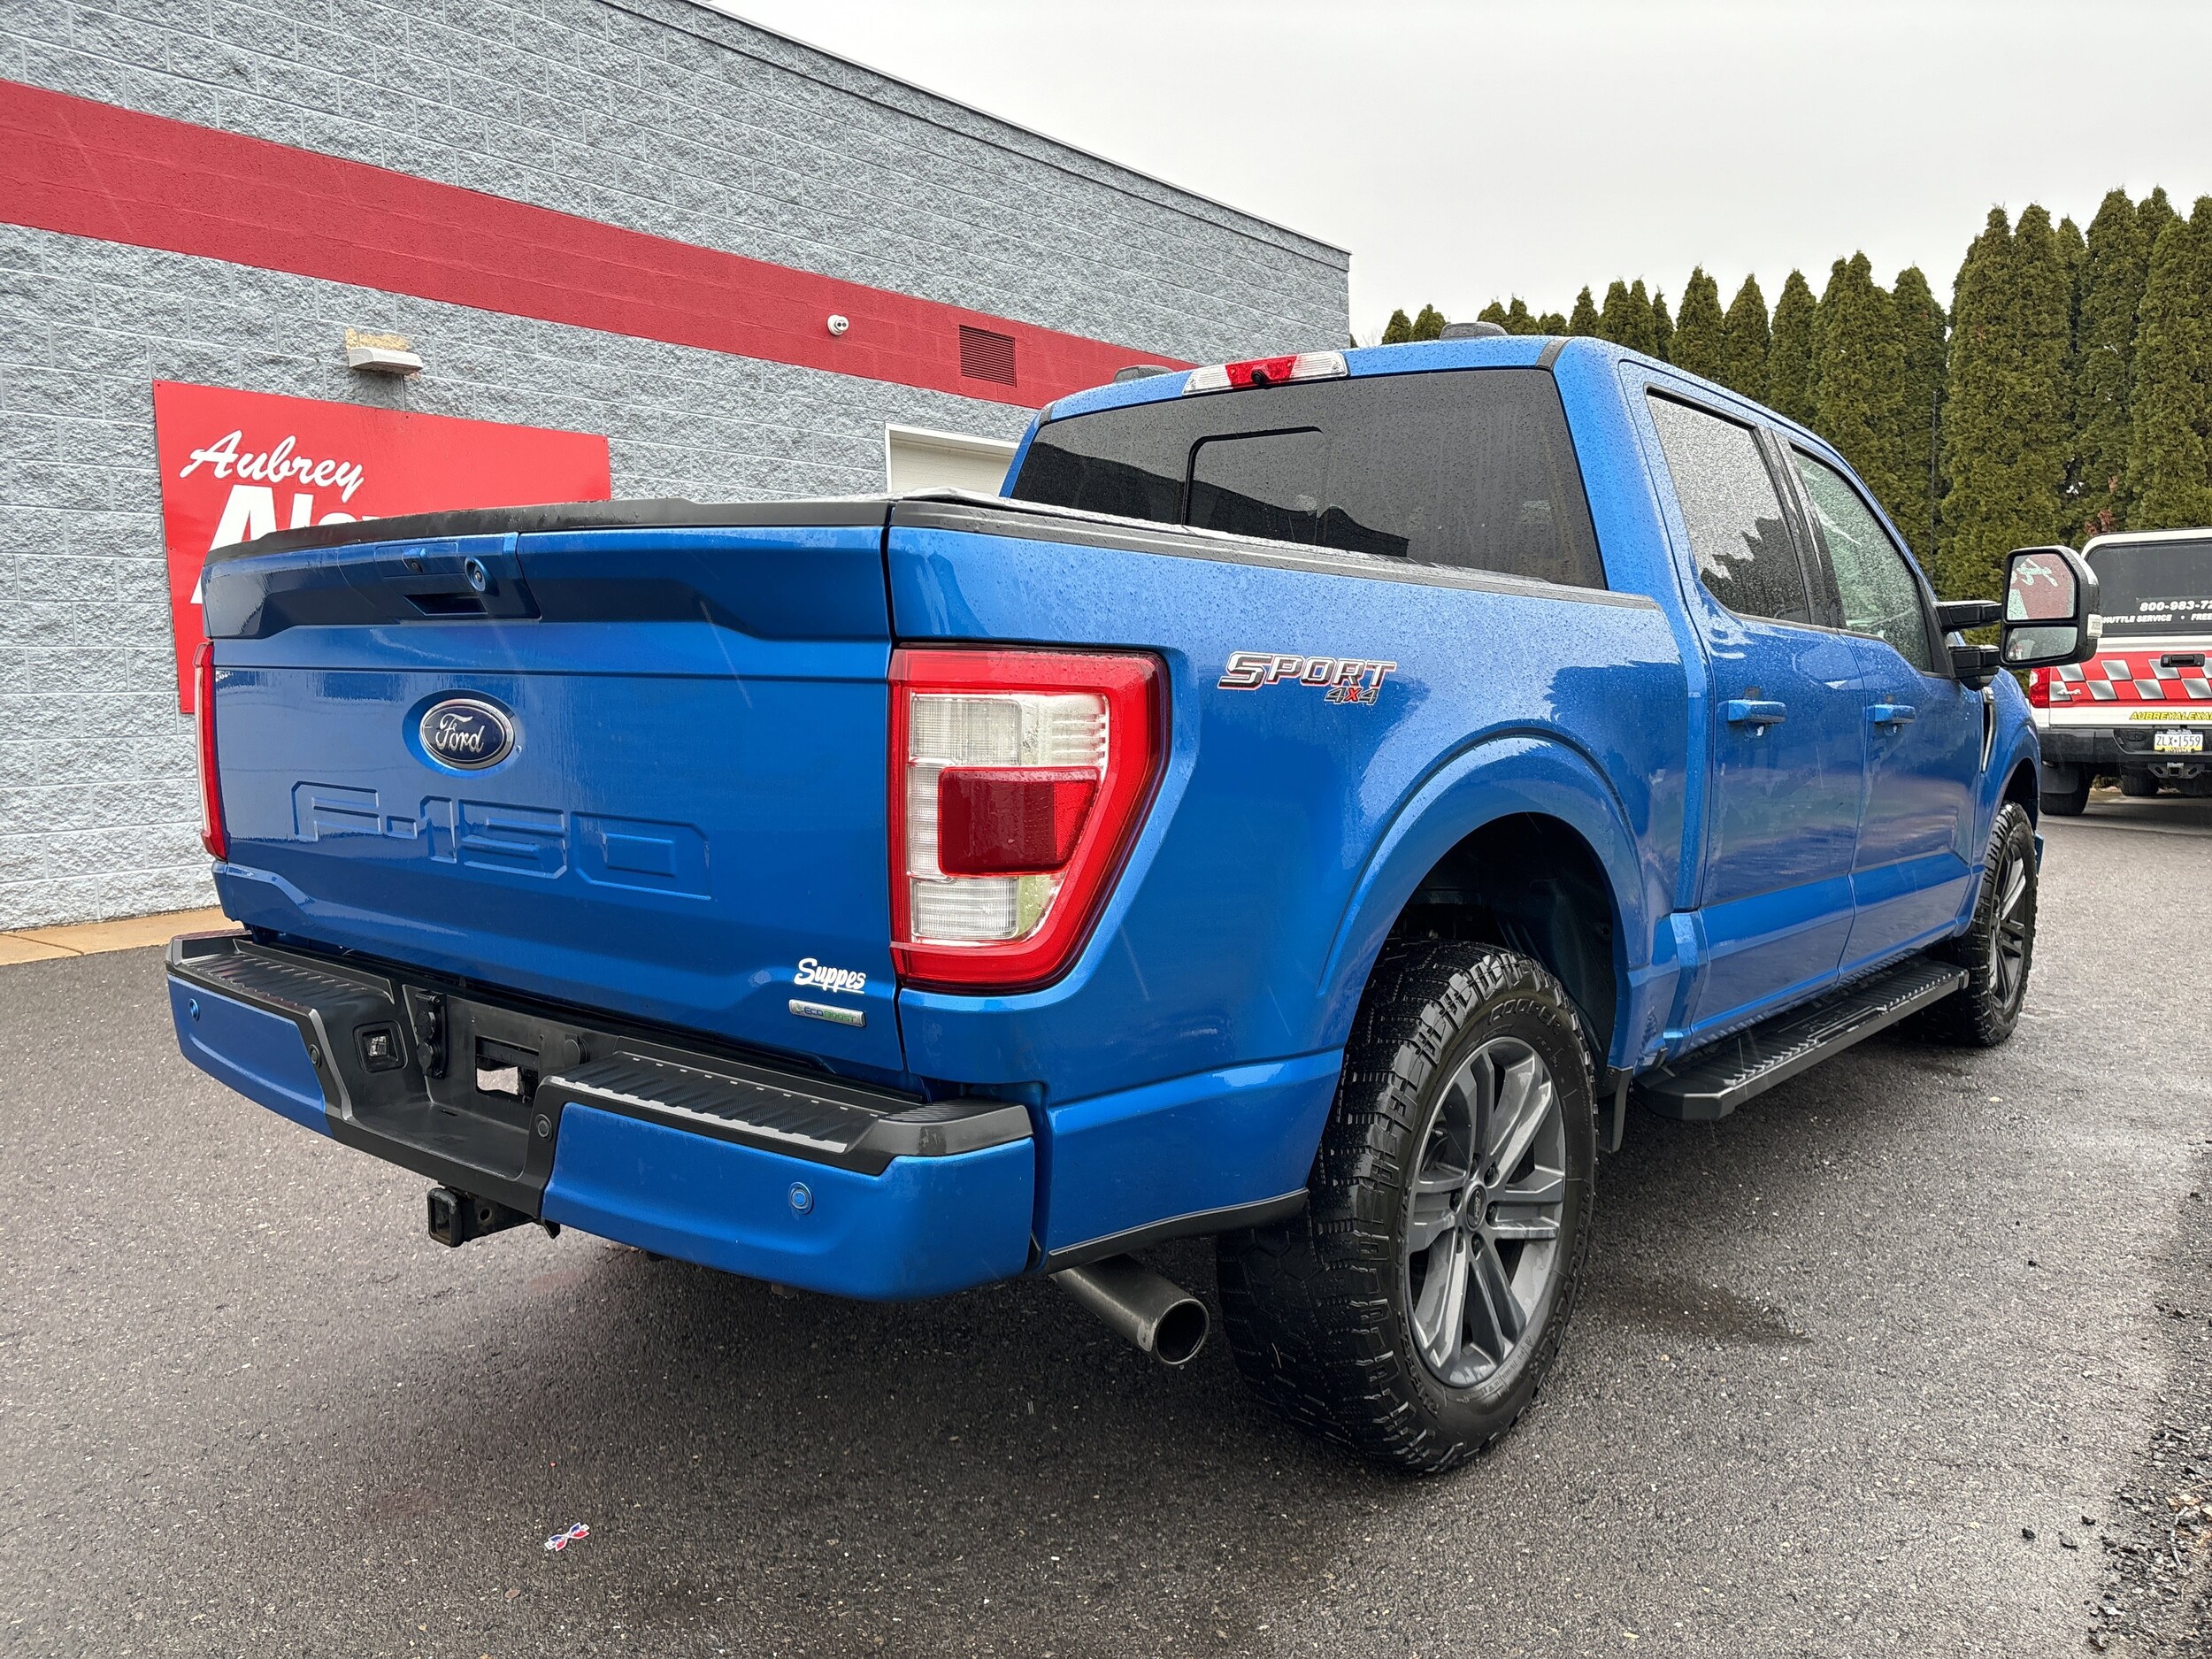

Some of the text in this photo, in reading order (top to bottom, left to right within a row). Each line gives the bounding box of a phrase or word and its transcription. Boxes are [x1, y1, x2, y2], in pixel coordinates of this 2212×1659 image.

[179, 430, 365, 503] Aubrey
[2101, 615, 2136, 624] HUTTLE
[2136, 614, 2173, 623] SERVICE
[1217, 651, 1397, 690] SPORT
[434, 713, 485, 754] Ford
[2129, 711, 2212, 720] AUBREYALEXA
[291, 780, 712, 901] F-150
[794, 957, 867, 995] Suppes
